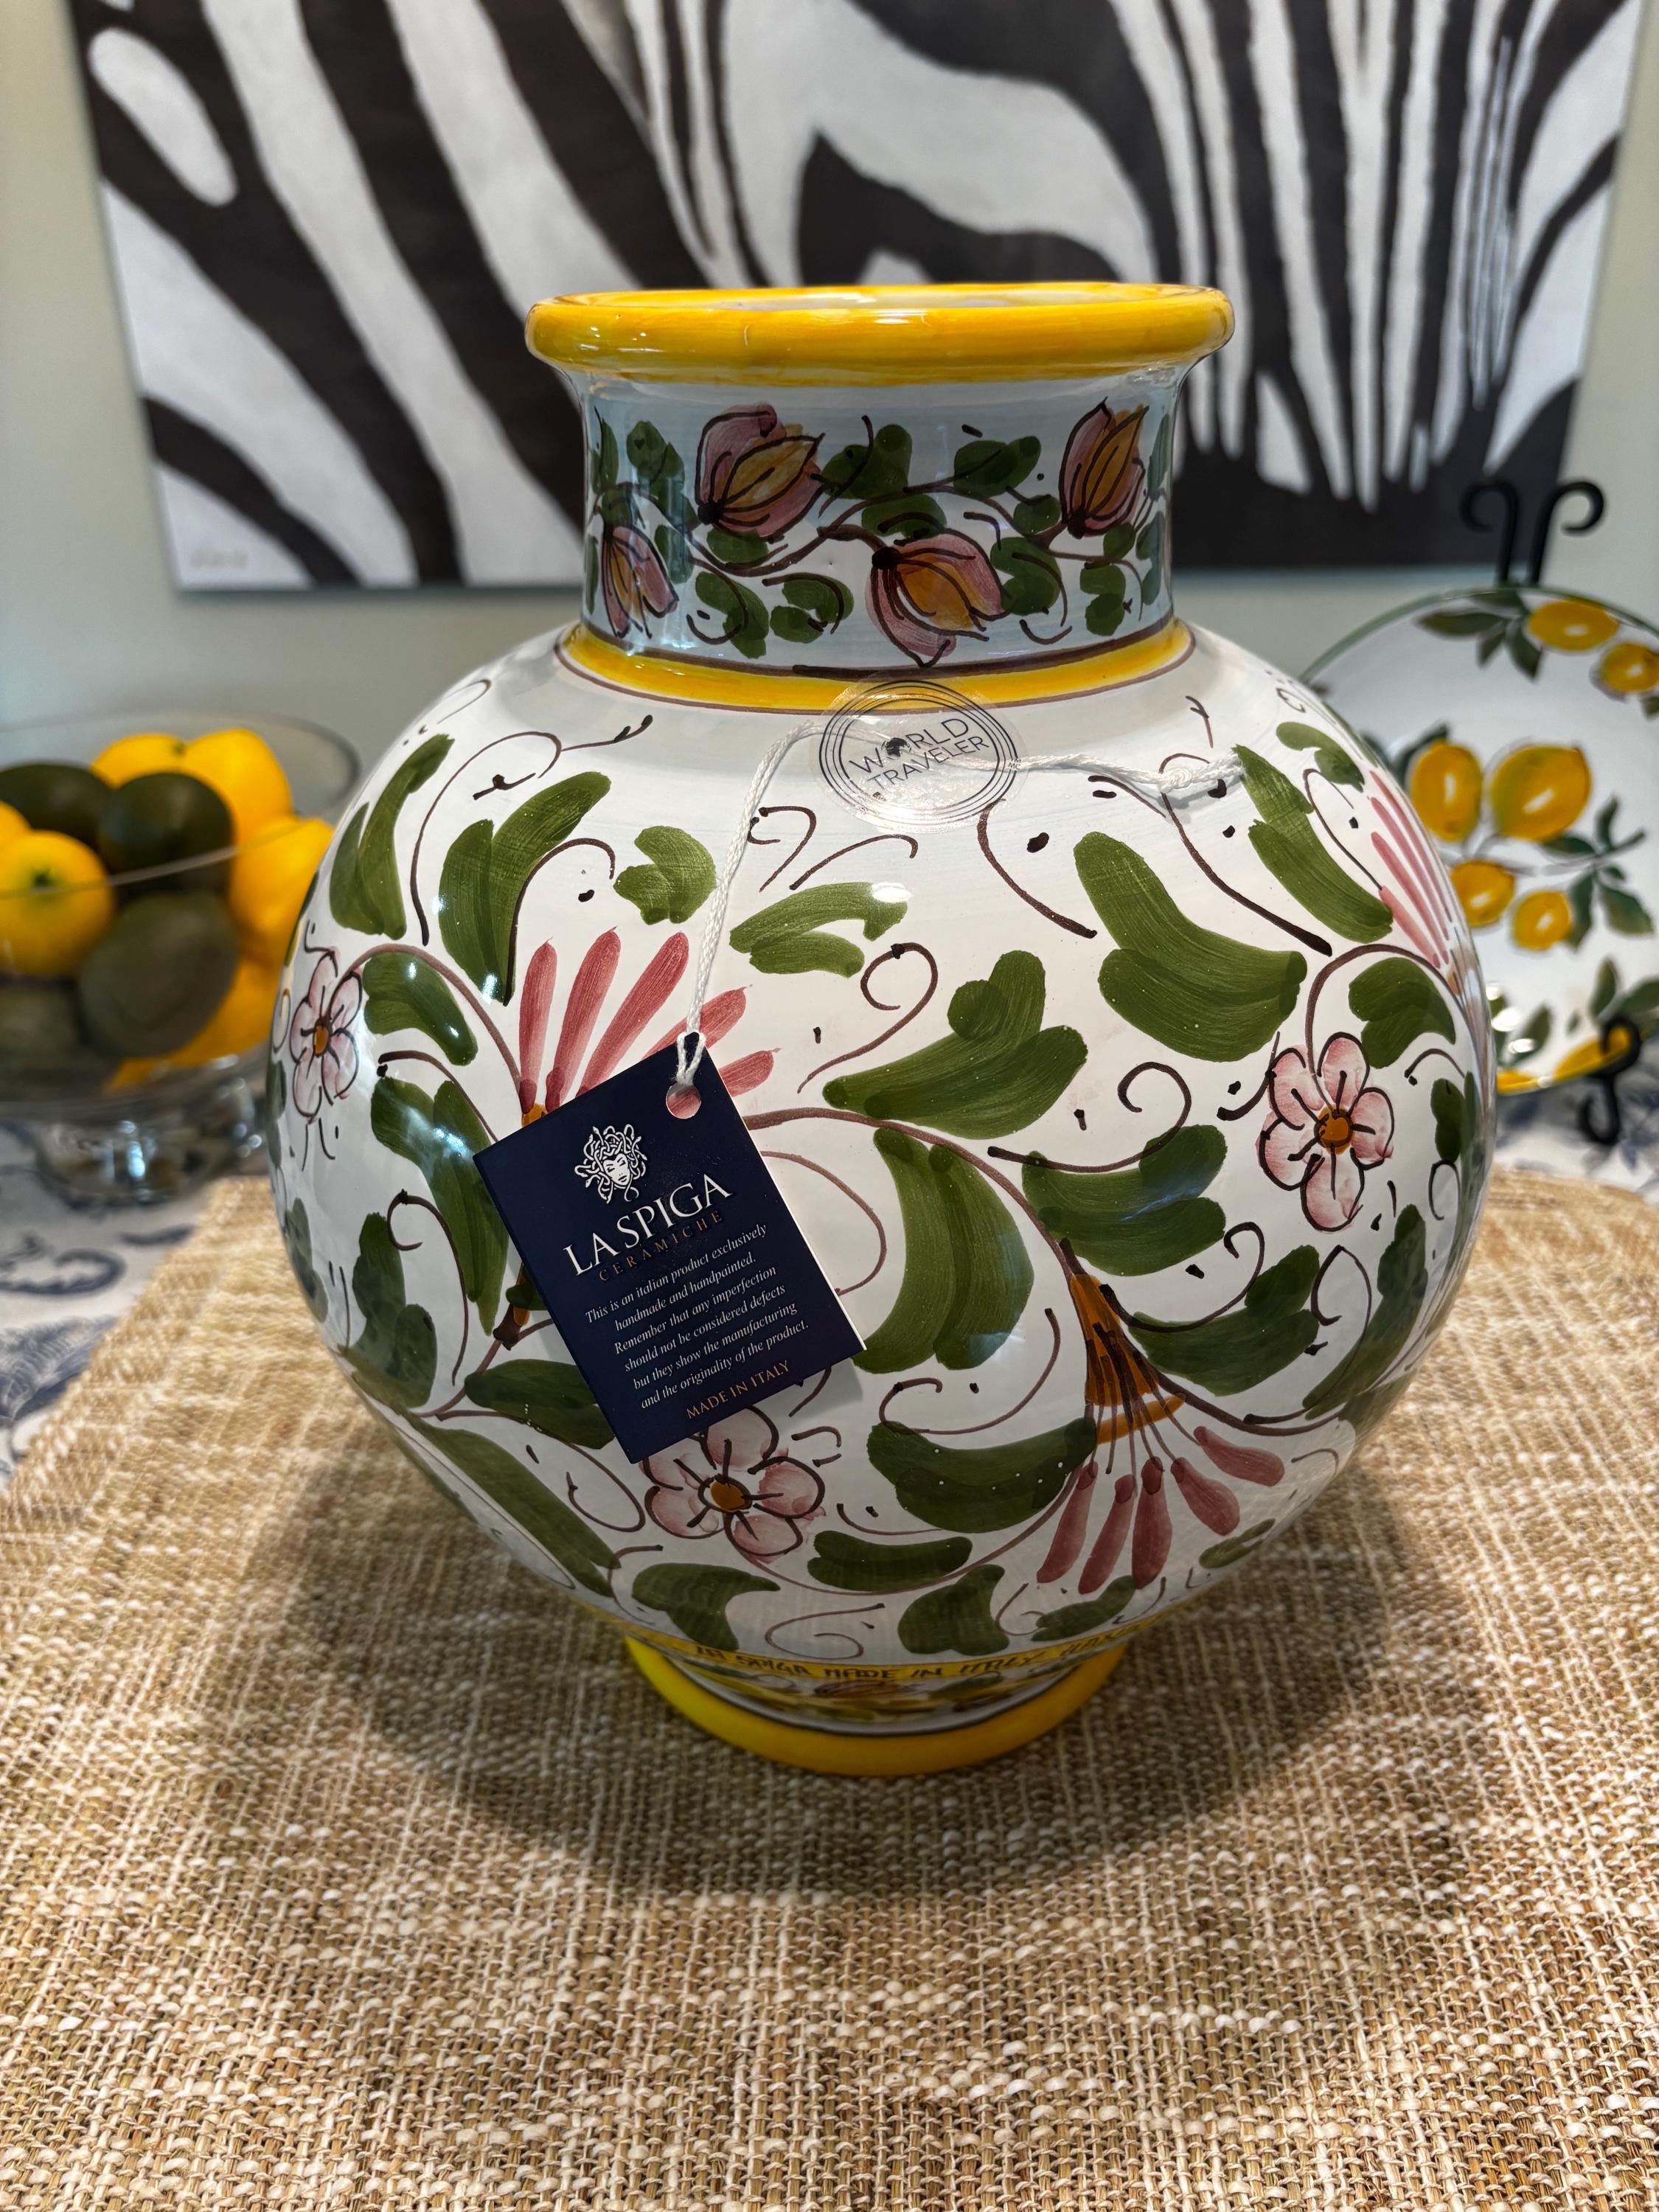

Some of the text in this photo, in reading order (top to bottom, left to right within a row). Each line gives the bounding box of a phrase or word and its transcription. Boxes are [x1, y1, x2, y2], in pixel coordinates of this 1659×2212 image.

[866, 736, 990, 790] TRAVELER
[562, 1173, 732, 1276] LA SPIGA
[598, 1212, 723, 1281] CERAMICHE
[584, 1223, 767, 1324] This is an italian product exclusively
[613, 1251, 757, 1332] handmade and handpainted.
[613, 1266, 777, 1355] Remember that any imperfection
[624, 1285, 786, 1373] should not be considered defects
[632, 1302, 799, 1391] but they show the manufacturing
[641, 1320, 810, 1410] and the originality of the product.
[686, 1359, 790, 1420] MADE IN ITALY
[736, 1655, 813, 1676] SPIGA
[824, 1668, 902, 1679] MADE
[910, 1667, 944, 1678] IN
